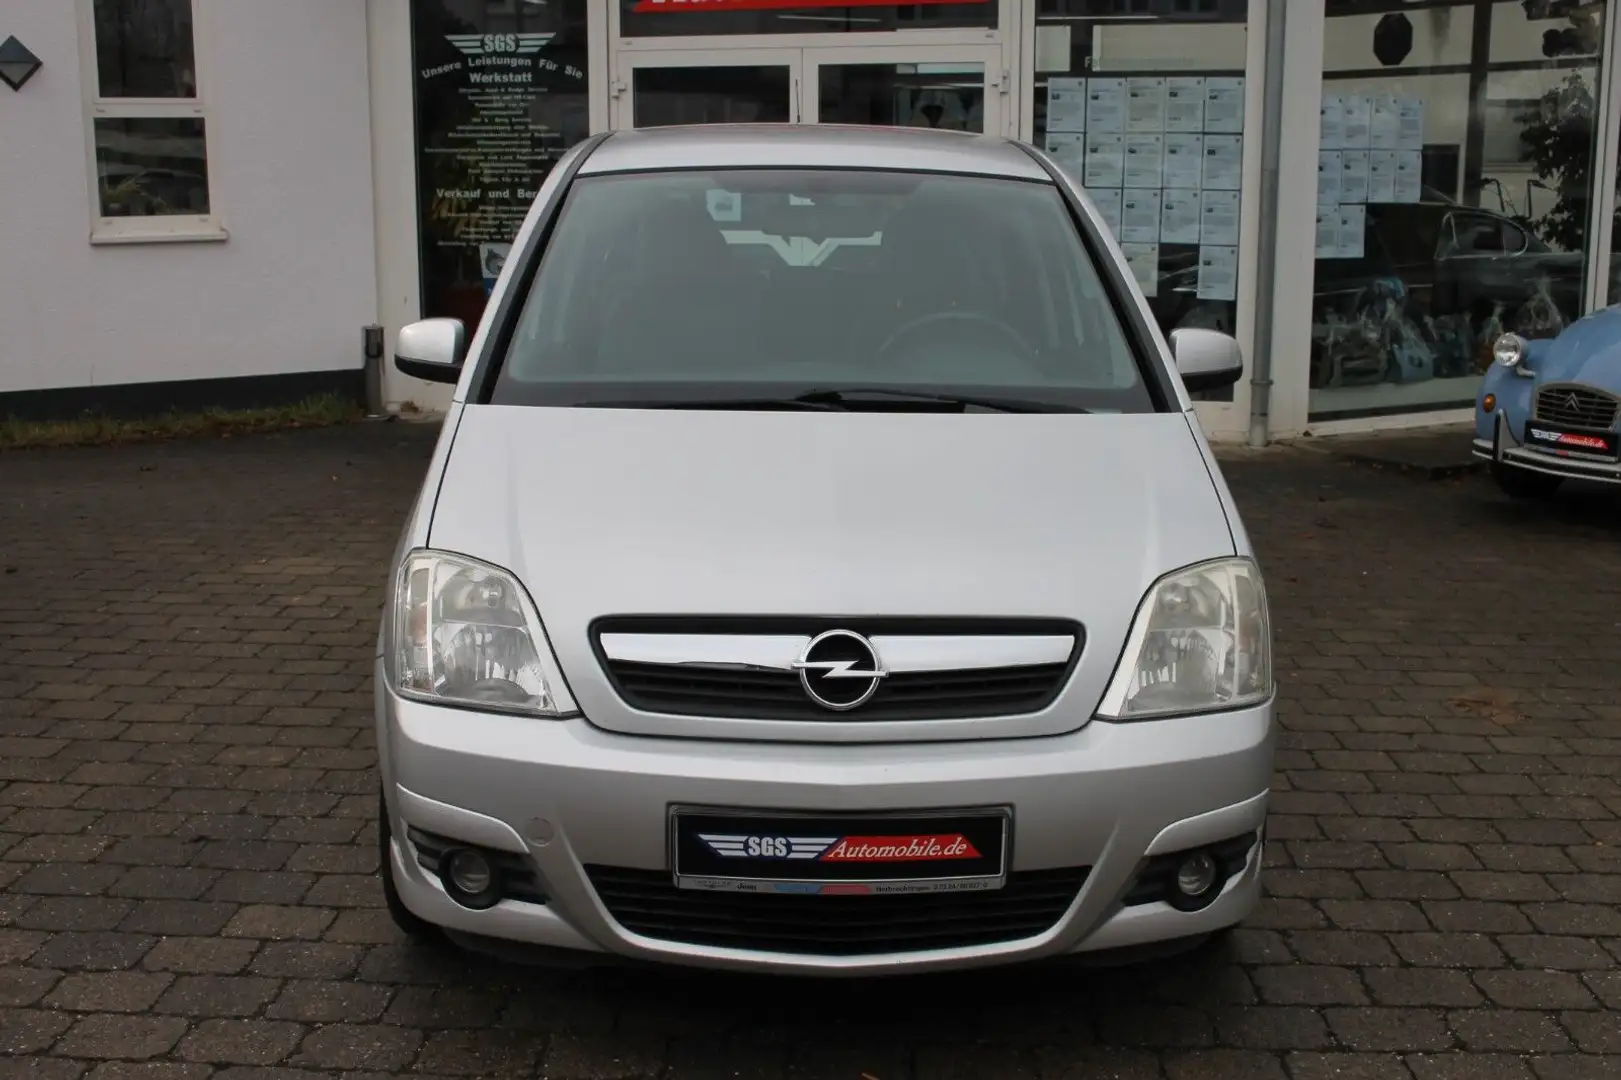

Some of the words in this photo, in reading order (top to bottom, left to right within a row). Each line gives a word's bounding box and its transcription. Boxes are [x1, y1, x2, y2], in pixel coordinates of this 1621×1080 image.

[484, 34, 517, 53] SGS
[421, 61, 462, 80] Unsere
[467, 57, 532, 68] Leistungen
[539, 59, 560, 72] Für
[564, 65, 584, 80] Sie
[469, 71, 533, 83] Werkstatt
[436, 188, 481, 199] Verkauf
[488, 188, 510, 199] und
[517, 188, 537, 199] Ber
[747, 837, 788, 857] SGS
[828, 836, 967, 859] Automobile.de
